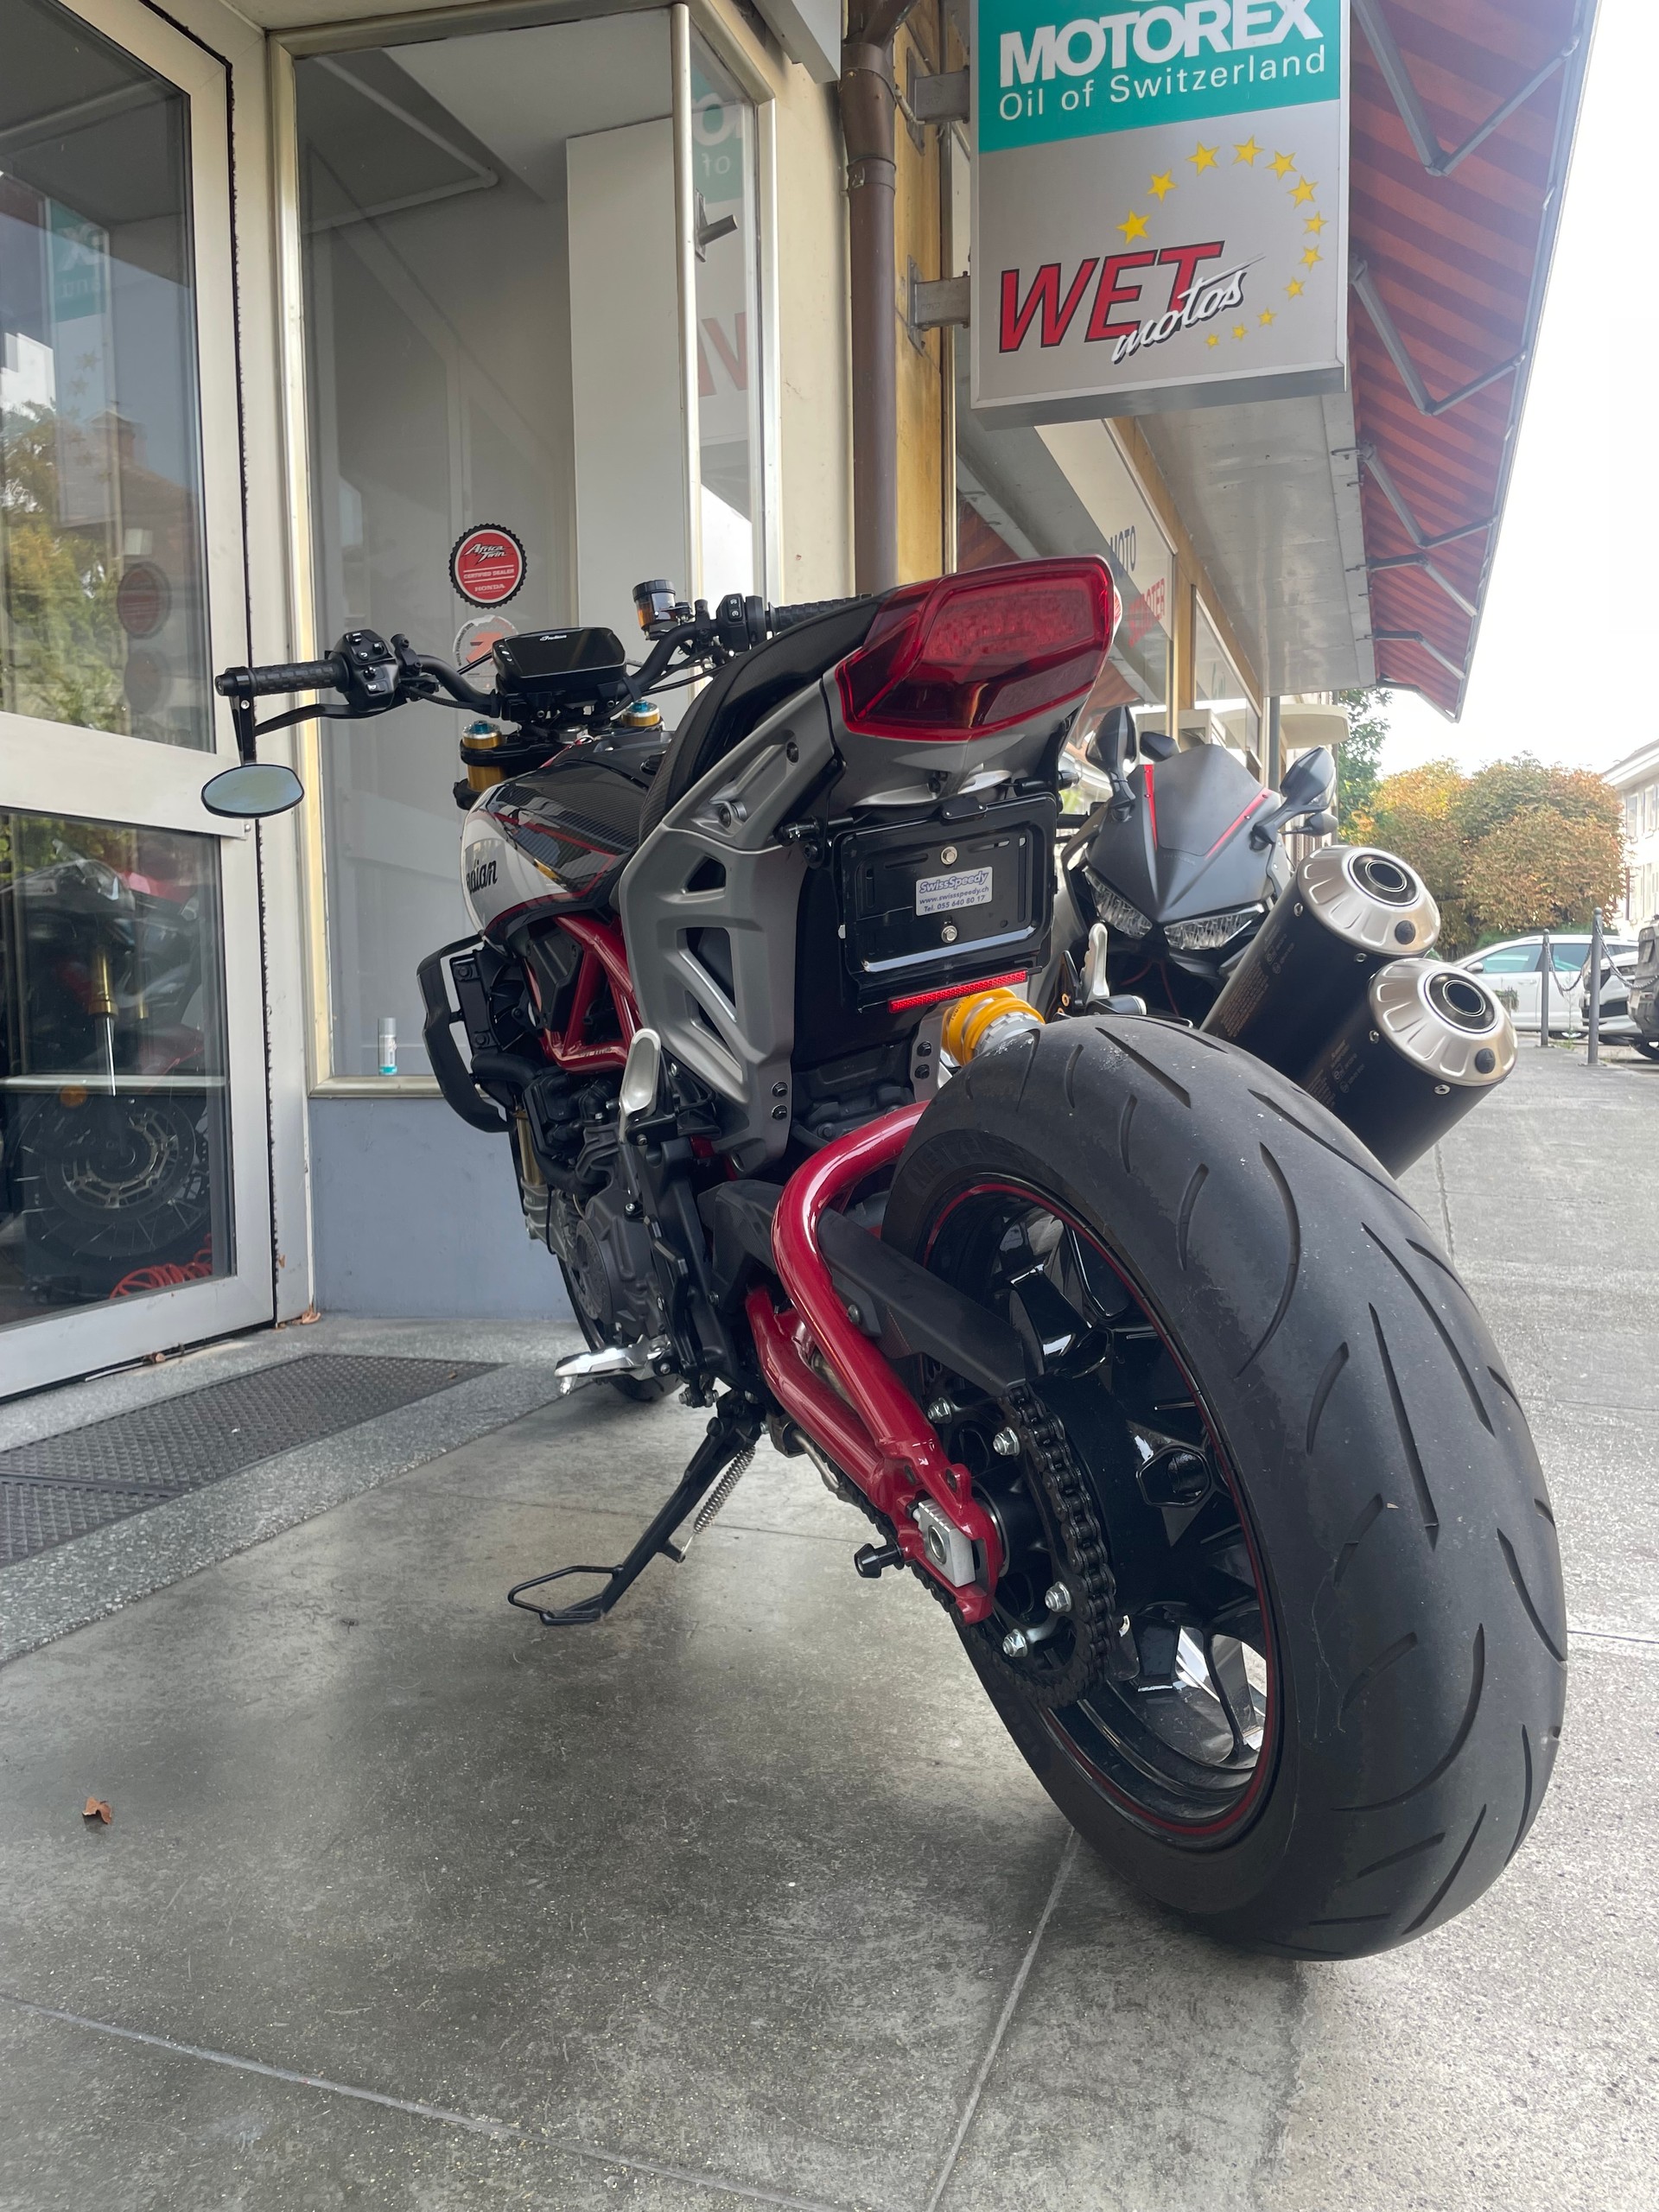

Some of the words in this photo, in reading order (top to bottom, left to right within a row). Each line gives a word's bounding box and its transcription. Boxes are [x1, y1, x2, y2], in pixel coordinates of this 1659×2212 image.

[999, 0, 1325, 87] MOTOREX
[999, 89, 1044, 121] Oil
[1061, 79, 1095, 111] of
[1109, 44, 1325, 104] Switzerland
[999, 239, 1225, 353] WET
[1110, 255, 1265, 365] motos
[462, 543, 508, 556] Africa
[476, 550, 510, 563] Twin
[474, 583, 505, 593] HONDA
[918, 870, 989, 894] SwissSpeedy
[918, 886, 989, 905] www.swissspeedy.ch
[937, 901, 950, 910] 055
